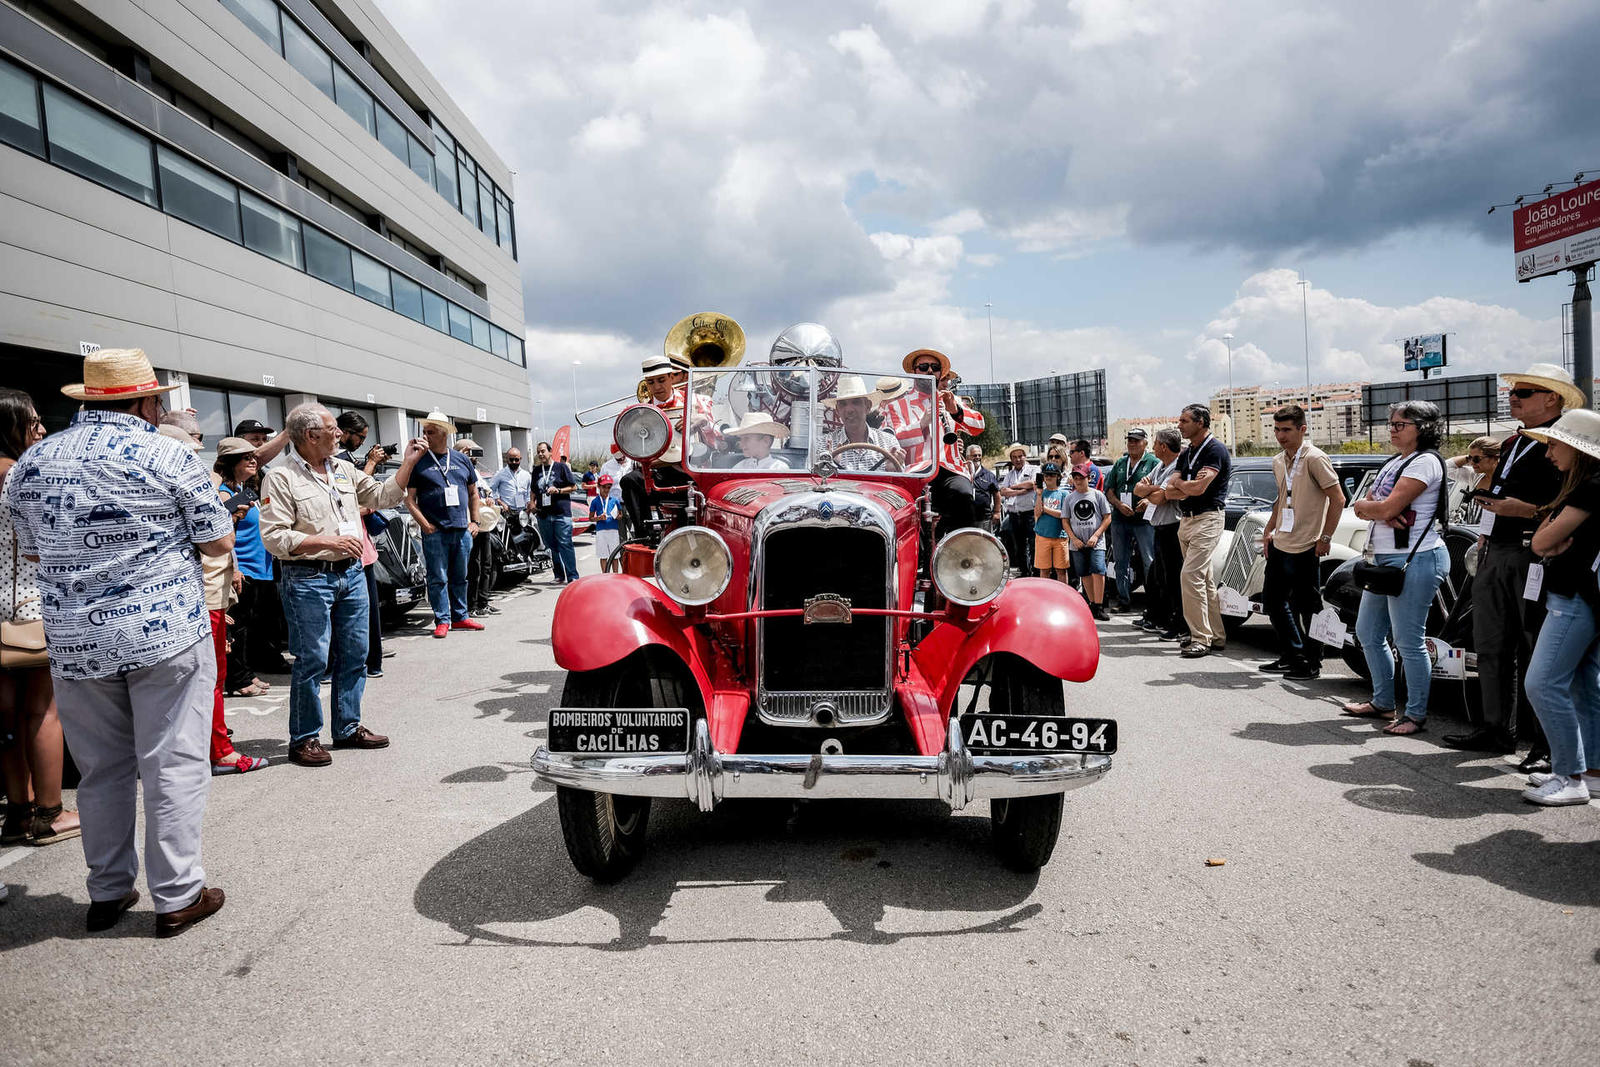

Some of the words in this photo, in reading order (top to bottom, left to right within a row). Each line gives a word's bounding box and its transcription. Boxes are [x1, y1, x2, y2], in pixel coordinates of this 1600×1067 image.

[1524, 204, 1557, 226] João
[1524, 211, 1580, 236] Empilhadores
[84, 531, 138, 549] CITROËN
[88, 603, 141, 626] CITROËN
[552, 712, 612, 727] BOMBEIROS
[615, 712, 684, 727] VOLUNTARIOS
[576, 734, 660, 751] CACILHAS
[967, 719, 1109, 751] AC-46-94
